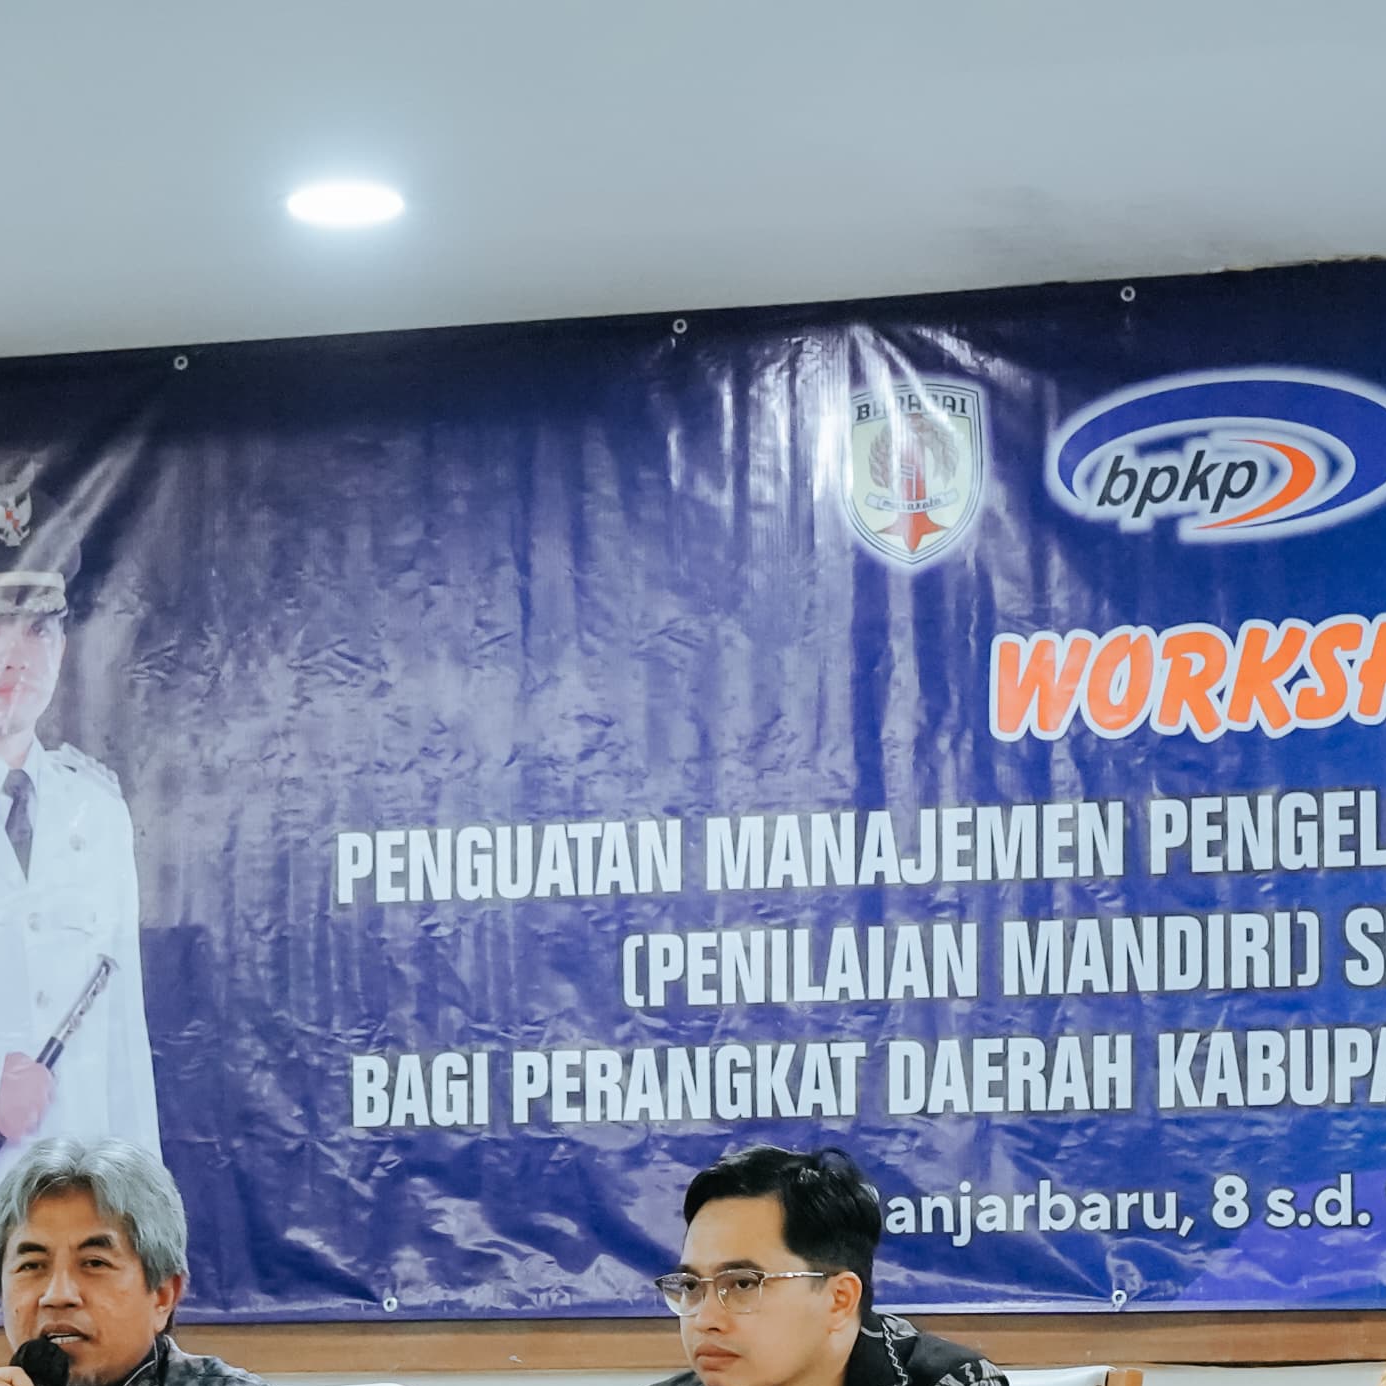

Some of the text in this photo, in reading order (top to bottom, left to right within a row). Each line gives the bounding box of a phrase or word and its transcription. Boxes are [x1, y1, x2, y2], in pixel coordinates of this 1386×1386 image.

[1097, 450, 1258, 518] bpkp
[338, 818, 682, 904] PENGUATAN
[706, 801, 1124, 890] MANAJEMEN
[622, 922, 978, 1008] (PENILAIAN
[1003, 911, 1319, 997] MANDIRI)
[352, 1052, 489, 1128] BAGI
[513, 1041, 866, 1123] PERANGKAT
[888, 1034, 1133, 1114] DAERAH
[871, 1179, 1195, 1247] anjarbaru,
[1212, 1173, 1250, 1229] 8
[1266, 1172, 1371, 1227] s.d.
